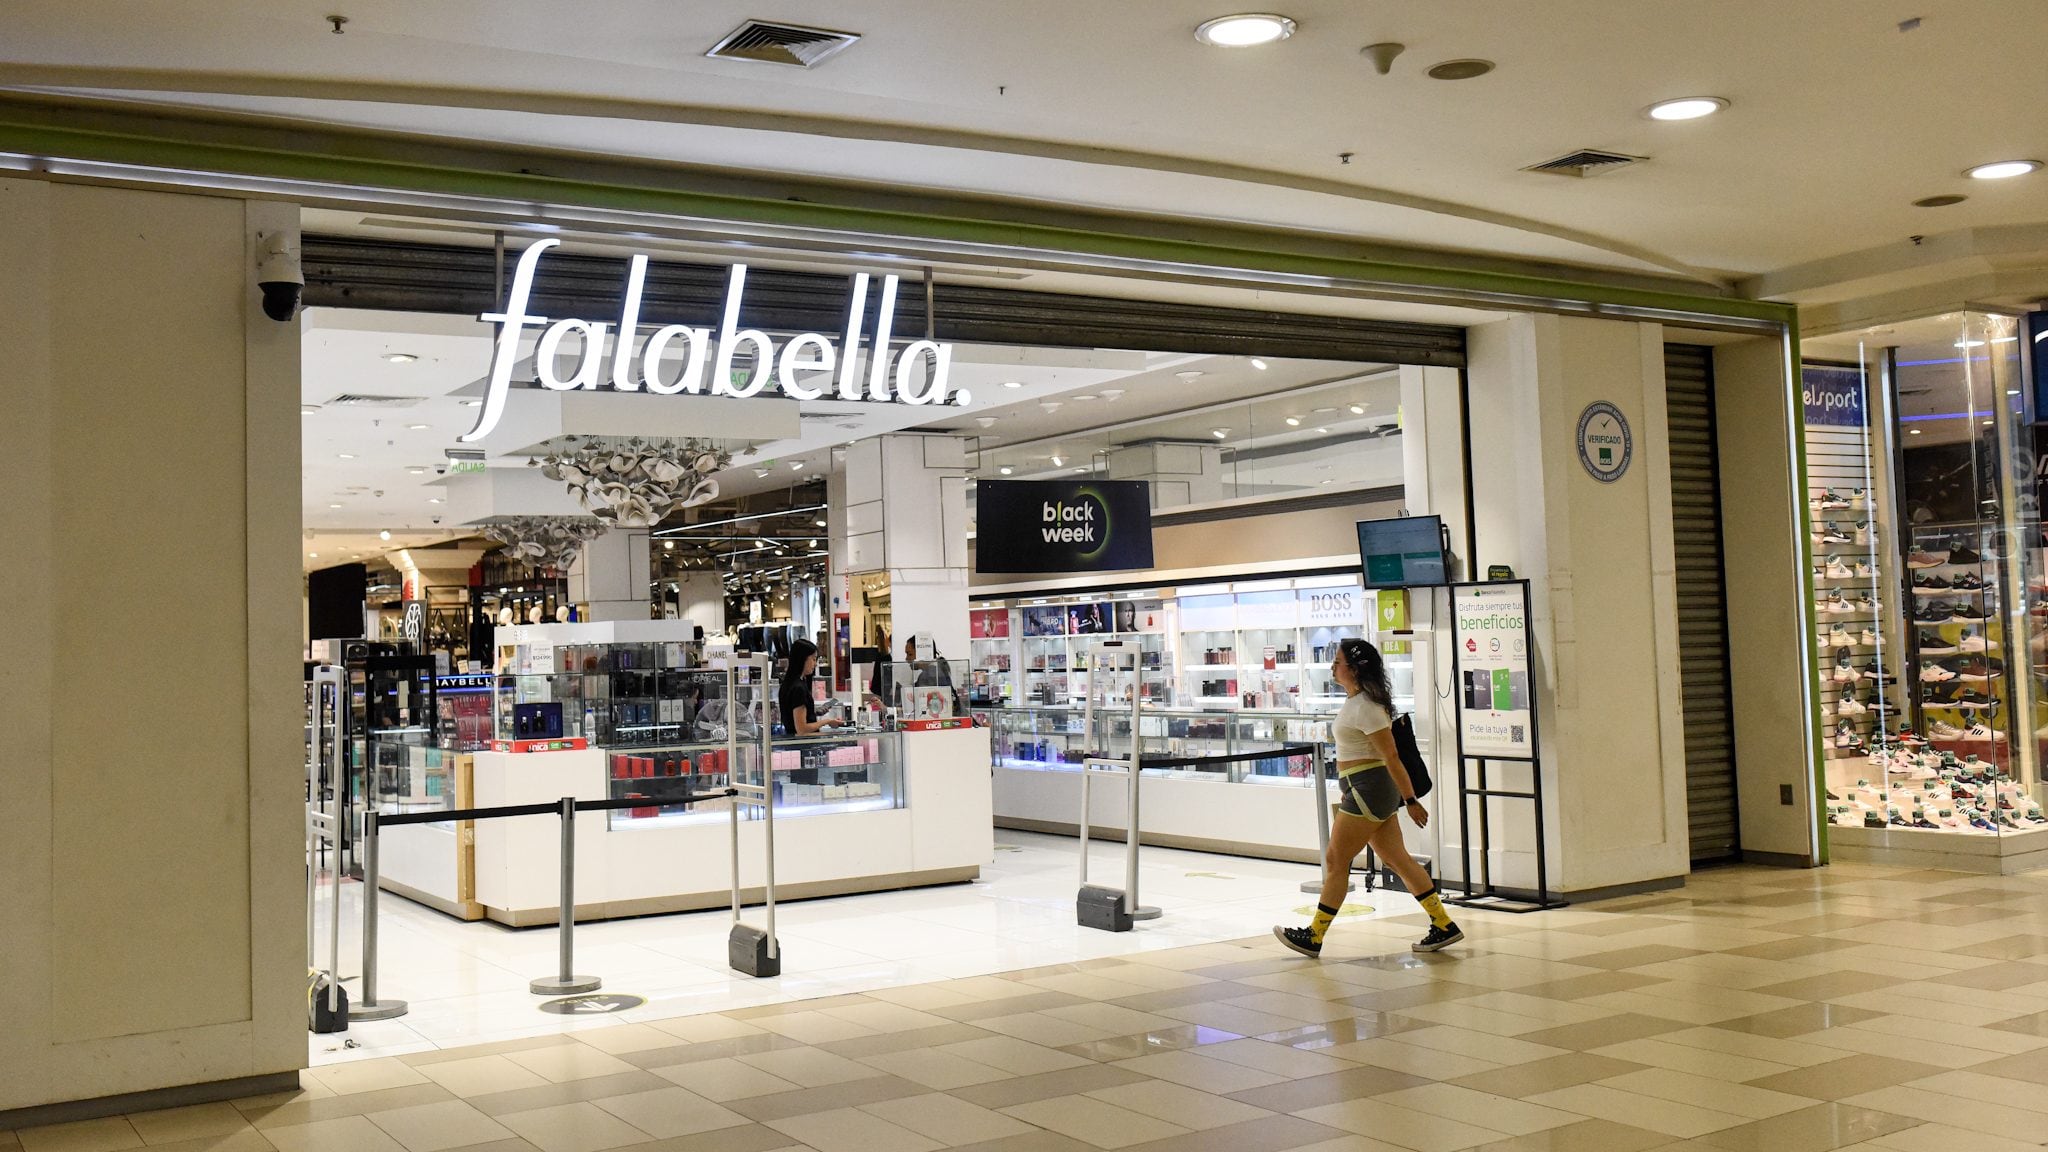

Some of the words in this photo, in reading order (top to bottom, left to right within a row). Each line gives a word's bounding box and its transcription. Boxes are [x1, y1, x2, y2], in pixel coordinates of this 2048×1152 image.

[1587, 435, 1621, 444] VERIFICADO
[1042, 522, 1094, 542] week
[1311, 593, 1351, 611] BOSS
[1459, 603, 1484, 612] Disfruta
[1485, 602, 1511, 612] siempre
[1512, 602, 1522, 610] tus
[1460, 614, 1523, 630] beneficios
[1384, 641, 1399, 651] DEA
[707, 651, 727, 659] CHANEL
[1469, 724, 1484, 733] Pide
[1485, 724, 1492, 733] la
[1493, 726, 1508, 735] tuya
